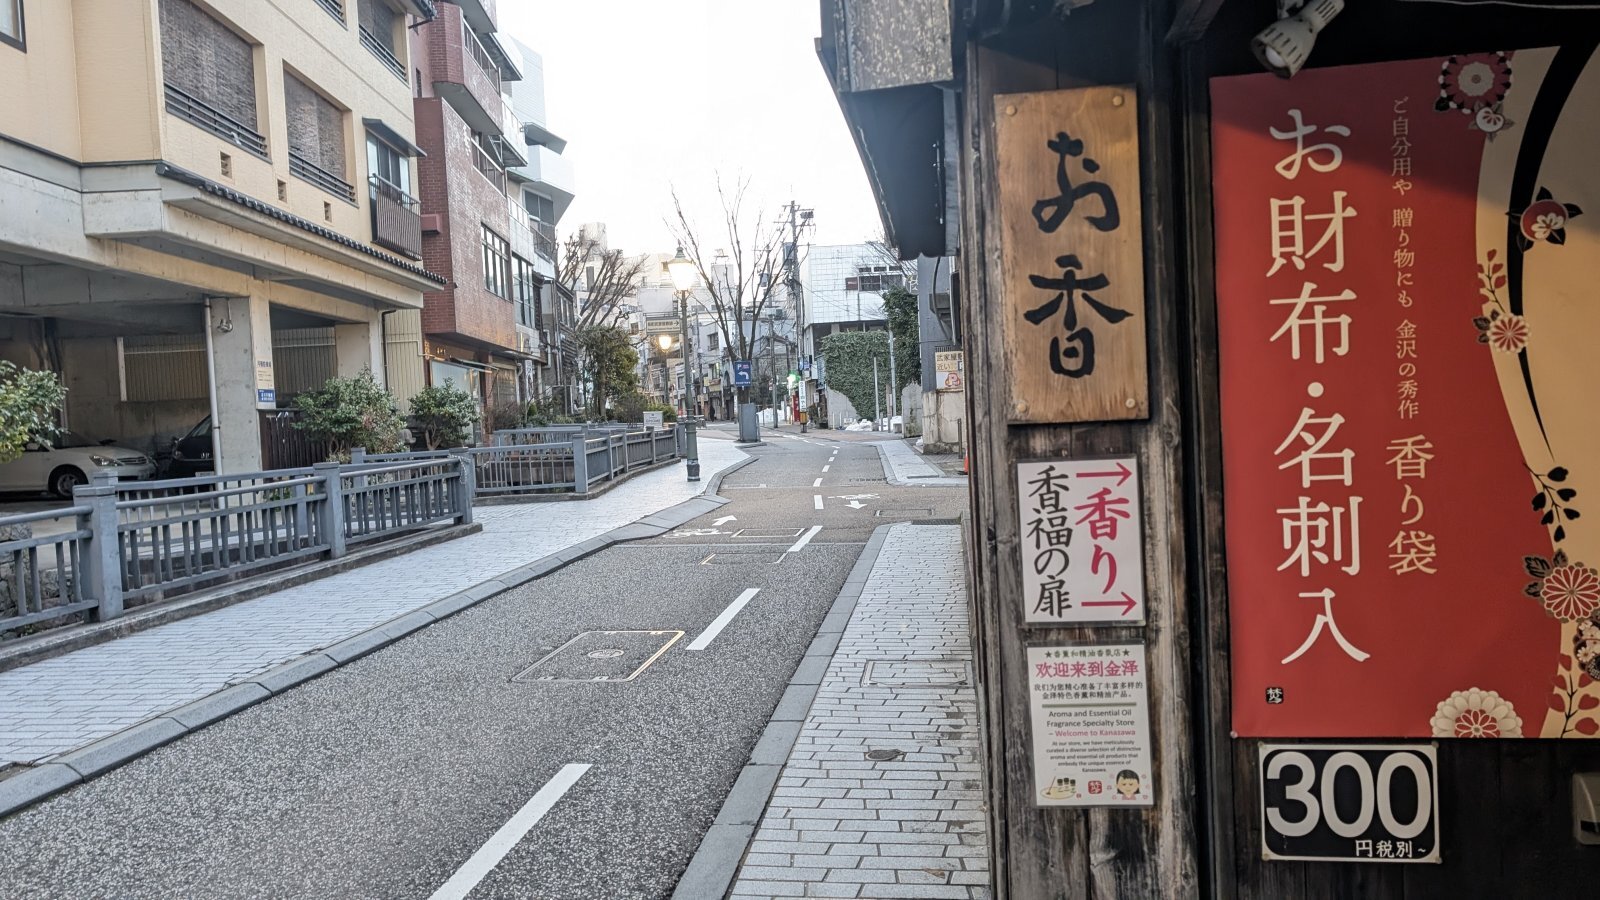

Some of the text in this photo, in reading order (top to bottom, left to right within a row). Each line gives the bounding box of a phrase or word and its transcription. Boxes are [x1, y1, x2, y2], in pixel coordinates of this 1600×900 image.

[1023, 131, 1133, 378] お香
[1392, 207, 1415, 308] 贈り物にも
[1265, 108, 1371, 664] お財布・名刺入
[1395, 319, 1419, 420] 金沢の秀作
[1026, 465, 1073, 618] 香福の扉
[1073, 487, 1131, 594] 香り
[1385, 434, 1438, 576] 香り袋
[1035, 660, 1139, 678] 欢迎来到金泽
[1089, 709, 1120, 717] Essential
[1266, 751, 1432, 839] 300
